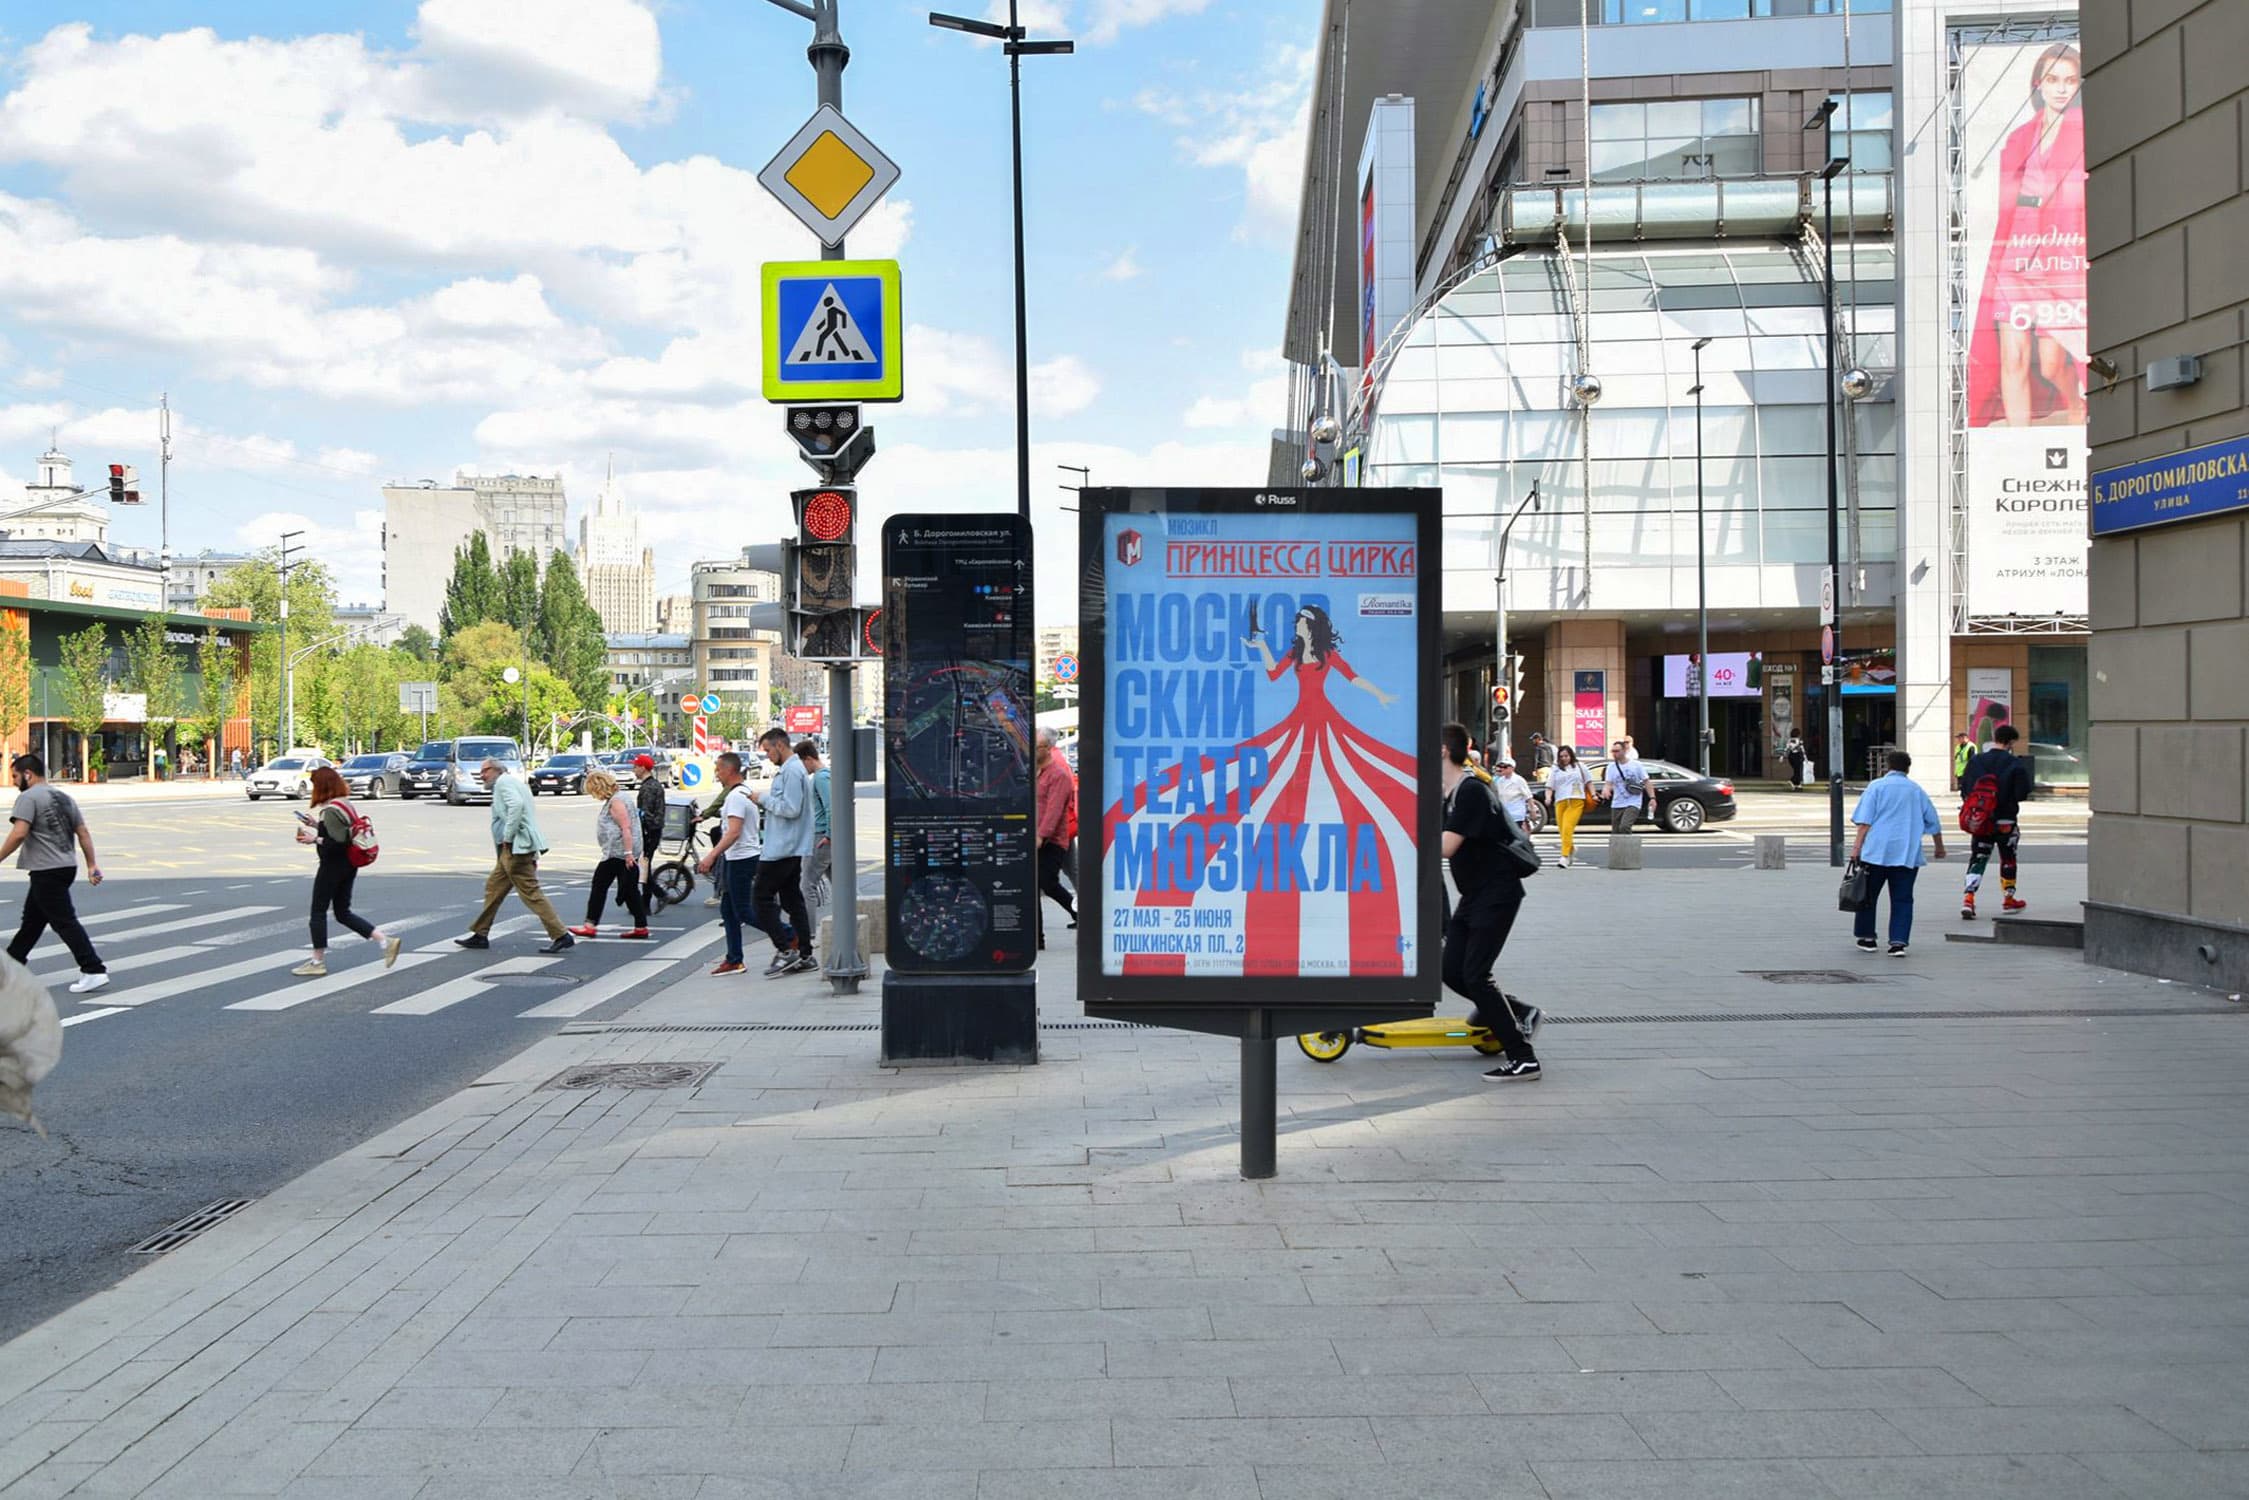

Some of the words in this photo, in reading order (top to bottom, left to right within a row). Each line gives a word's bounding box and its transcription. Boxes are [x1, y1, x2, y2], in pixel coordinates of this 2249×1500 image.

[2095, 485, 2106, 504] Б.
[2109, 452, 2249, 503] ДОРОГОМИЛОВСКА
[1268, 494, 1297, 505] Russ
[1167, 519, 1218, 536] МЮЗИКЛ
[1167, 543, 1320, 578] ПРИНЦЕССА
[1328, 543, 1416, 578] ЦИРКА
[2034, 557, 2041, 566] 3
[2045, 557, 2080, 566] ЭТАЖ
[1997, 569, 2046, 578] АТРИУМ
[1115, 664, 1255, 739] СКИЙ
[1576, 708, 1604, 719] SALE
[1114, 746, 1269, 815] ТЕАТР
[1114, 822, 1383, 893] МЮЗИКЛА
[1113, 908, 1130, 928] 27
[1133, 908, 1160, 928] МАЯ
[1174, 908, 1190, 928] 25
[1194, 908, 1232, 928] ИЮНЯ
[1113, 934, 1202, 953] ПУШКИНСКАЯ
[1236, 934, 1244, 953] 2
